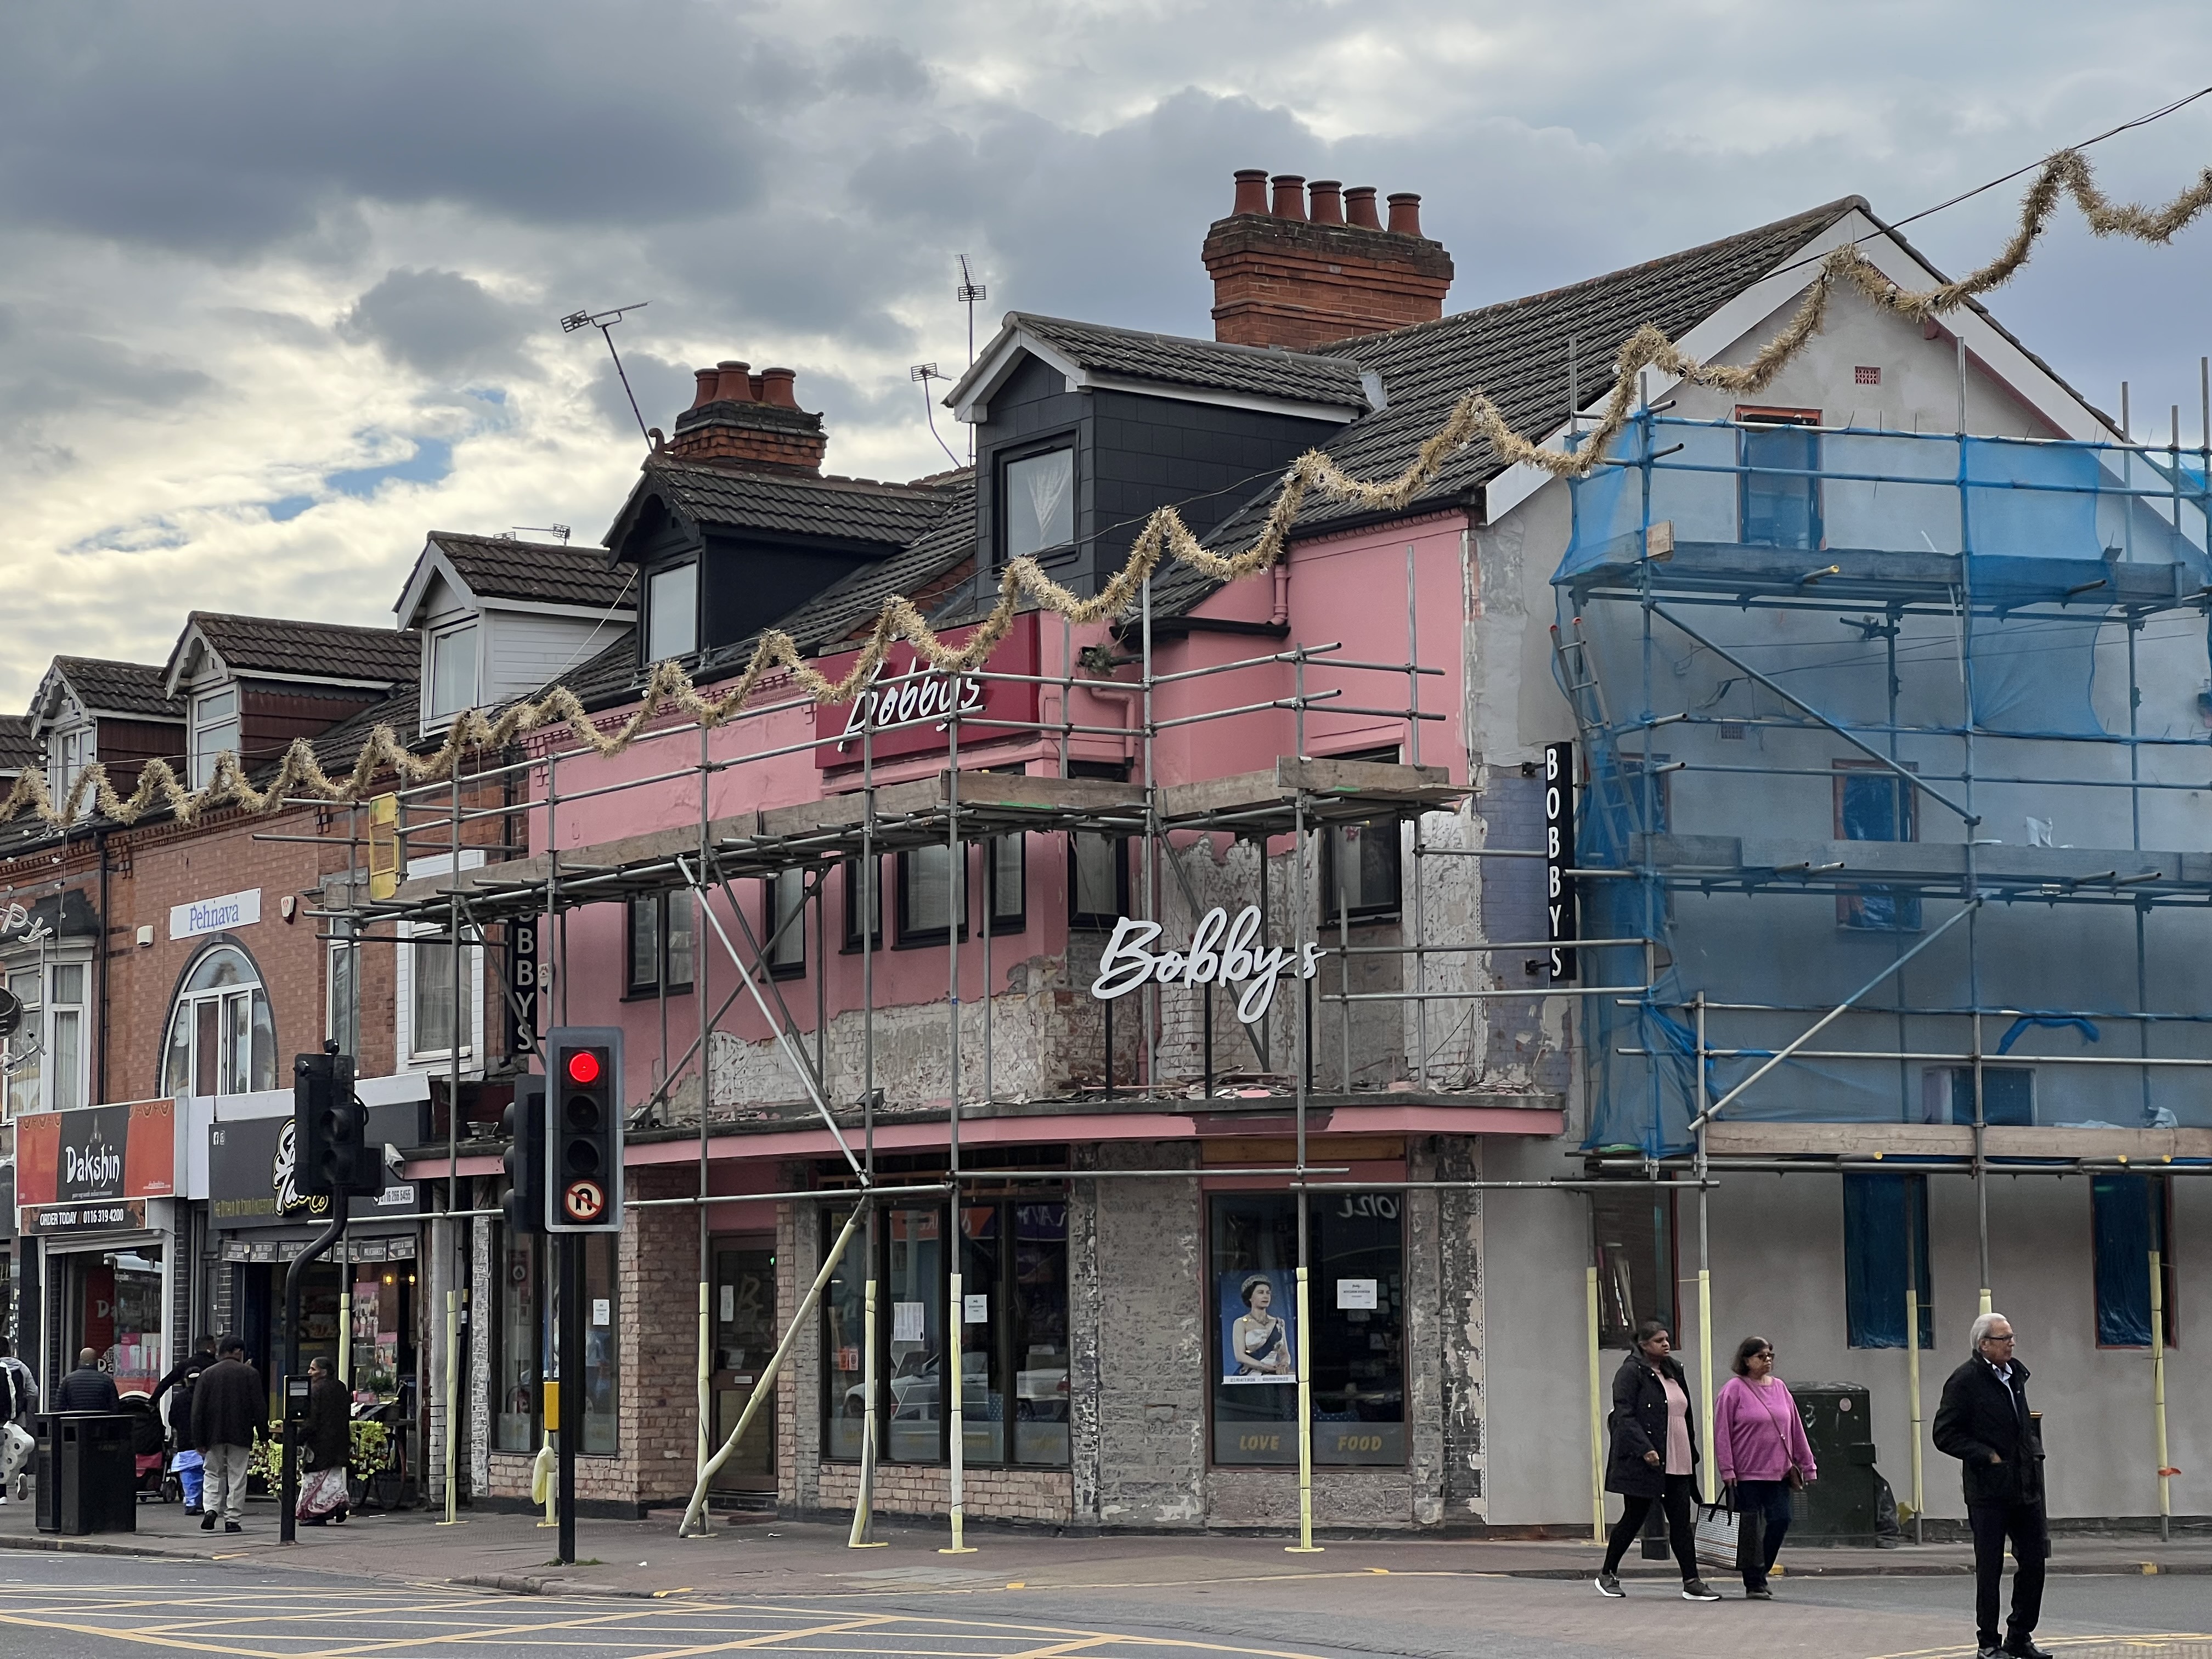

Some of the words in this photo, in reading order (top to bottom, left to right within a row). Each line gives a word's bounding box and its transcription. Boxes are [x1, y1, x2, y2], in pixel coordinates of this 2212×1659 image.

[1547, 748, 1562, 977] BOBBYS
[189, 904, 239, 931] Pehnava
[515, 912, 534, 1050] BBYS
[65, 1144, 120, 1188] Dakshin
[40, 1213, 58, 1226] ORDER
[59, 1211, 77, 1225] TODAY
[83, 1210, 97, 1223] 0116
[97, 1209, 109, 1223] 319
[109, 1208, 124, 1222] 4200
[1239, 1435, 1280, 1451] LOVE
[1338, 1436, 1383, 1451] FOOD
